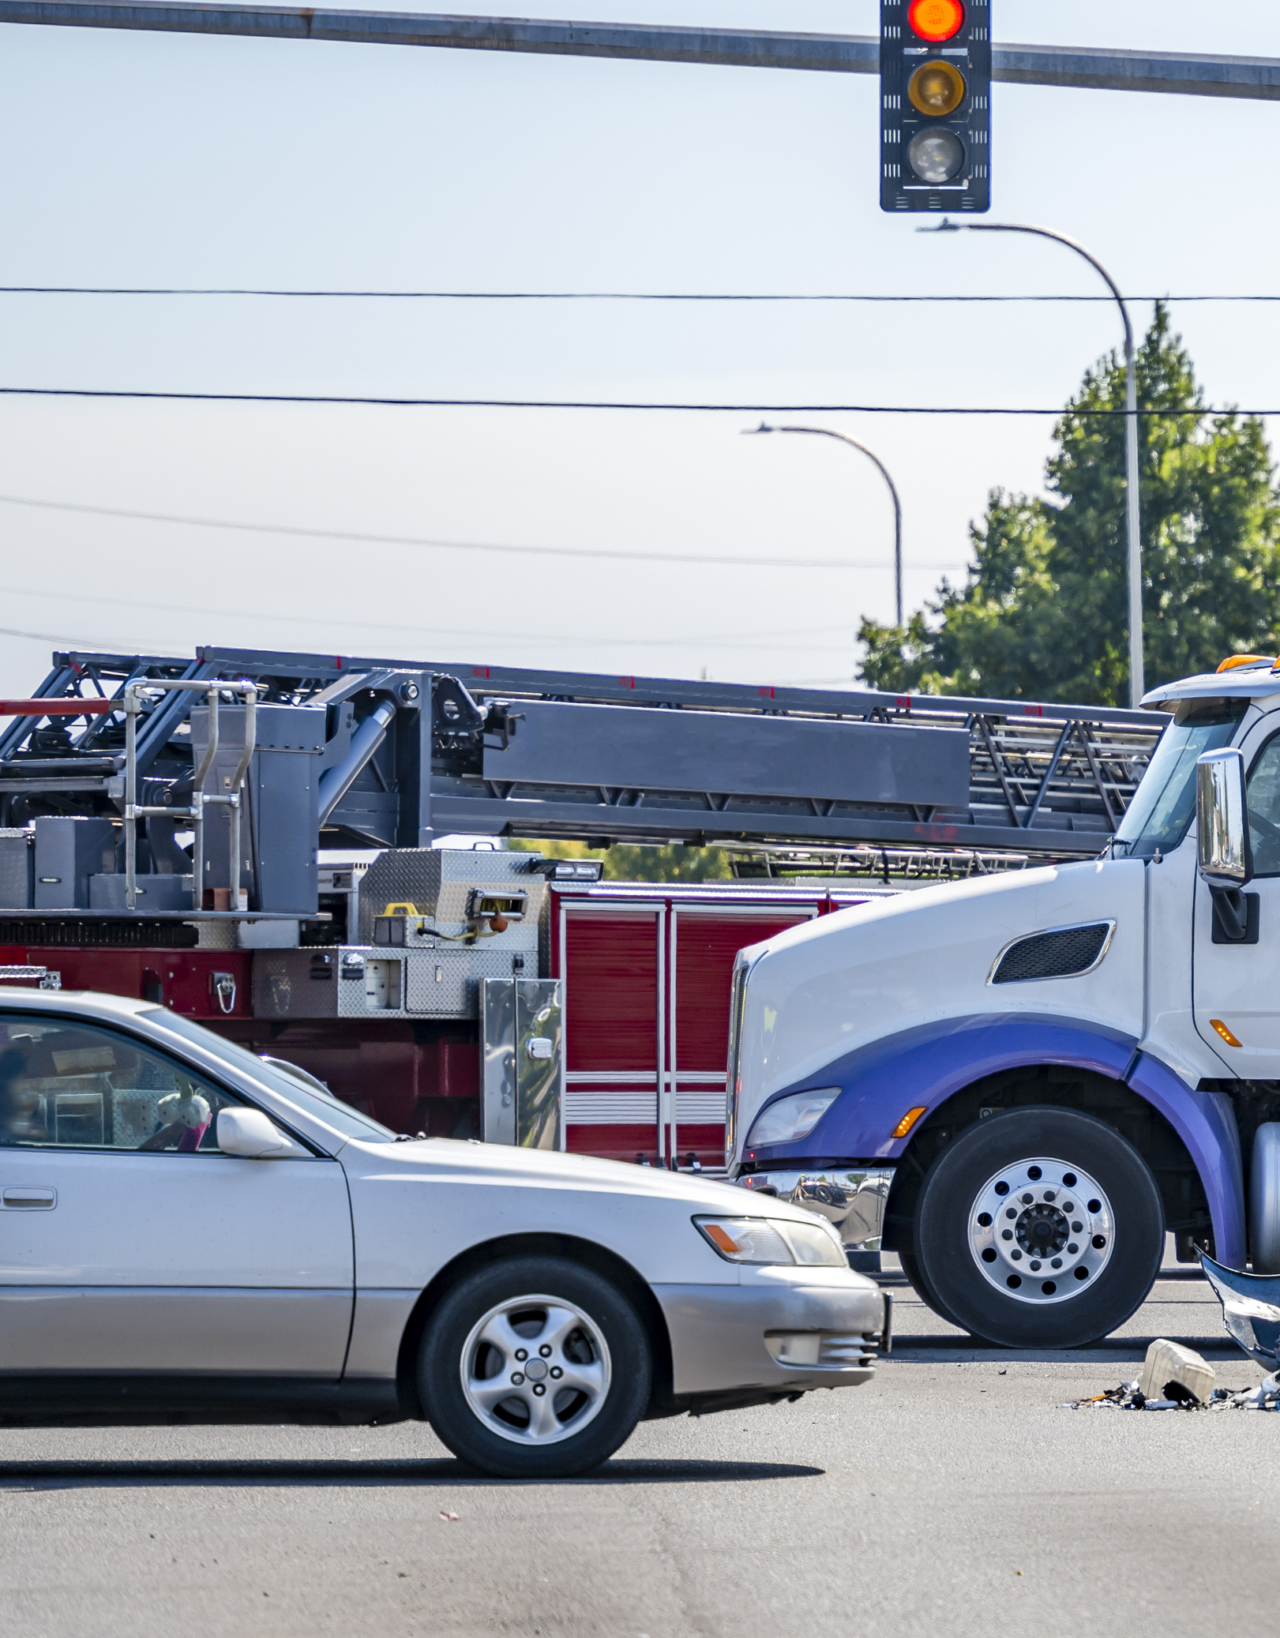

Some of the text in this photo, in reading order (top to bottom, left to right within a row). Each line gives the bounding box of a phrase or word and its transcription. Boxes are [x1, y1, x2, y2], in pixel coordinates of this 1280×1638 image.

[473, 667, 484, 676] 60
[619, 677, 628, 686] 70
[759, 687, 769, 696] 80
[895, 697, 905, 706] 90
